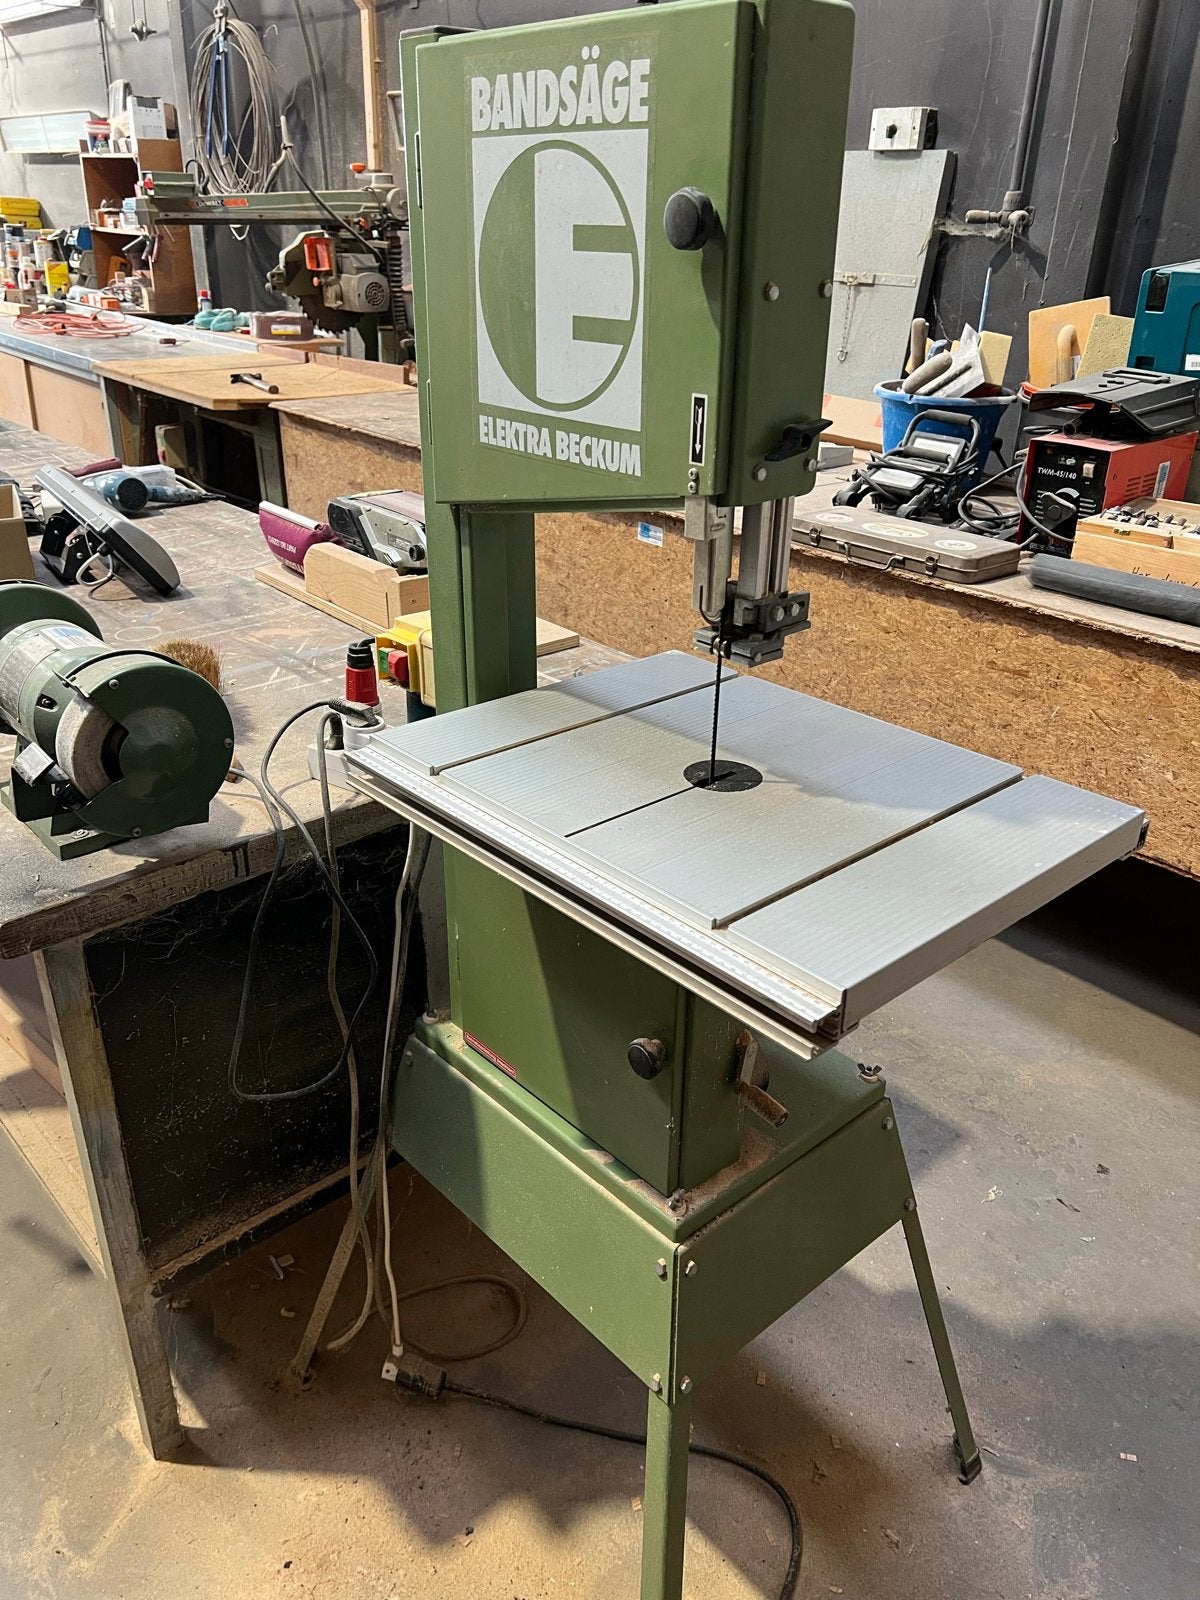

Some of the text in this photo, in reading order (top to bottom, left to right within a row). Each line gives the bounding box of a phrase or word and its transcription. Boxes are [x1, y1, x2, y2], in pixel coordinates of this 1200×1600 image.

[471, 45, 650, 132] BANDSÄGE
[479, 414, 642, 477] ELEKTRA BECKUM
[1037, 466, 1077, 480] TWM-45/140
